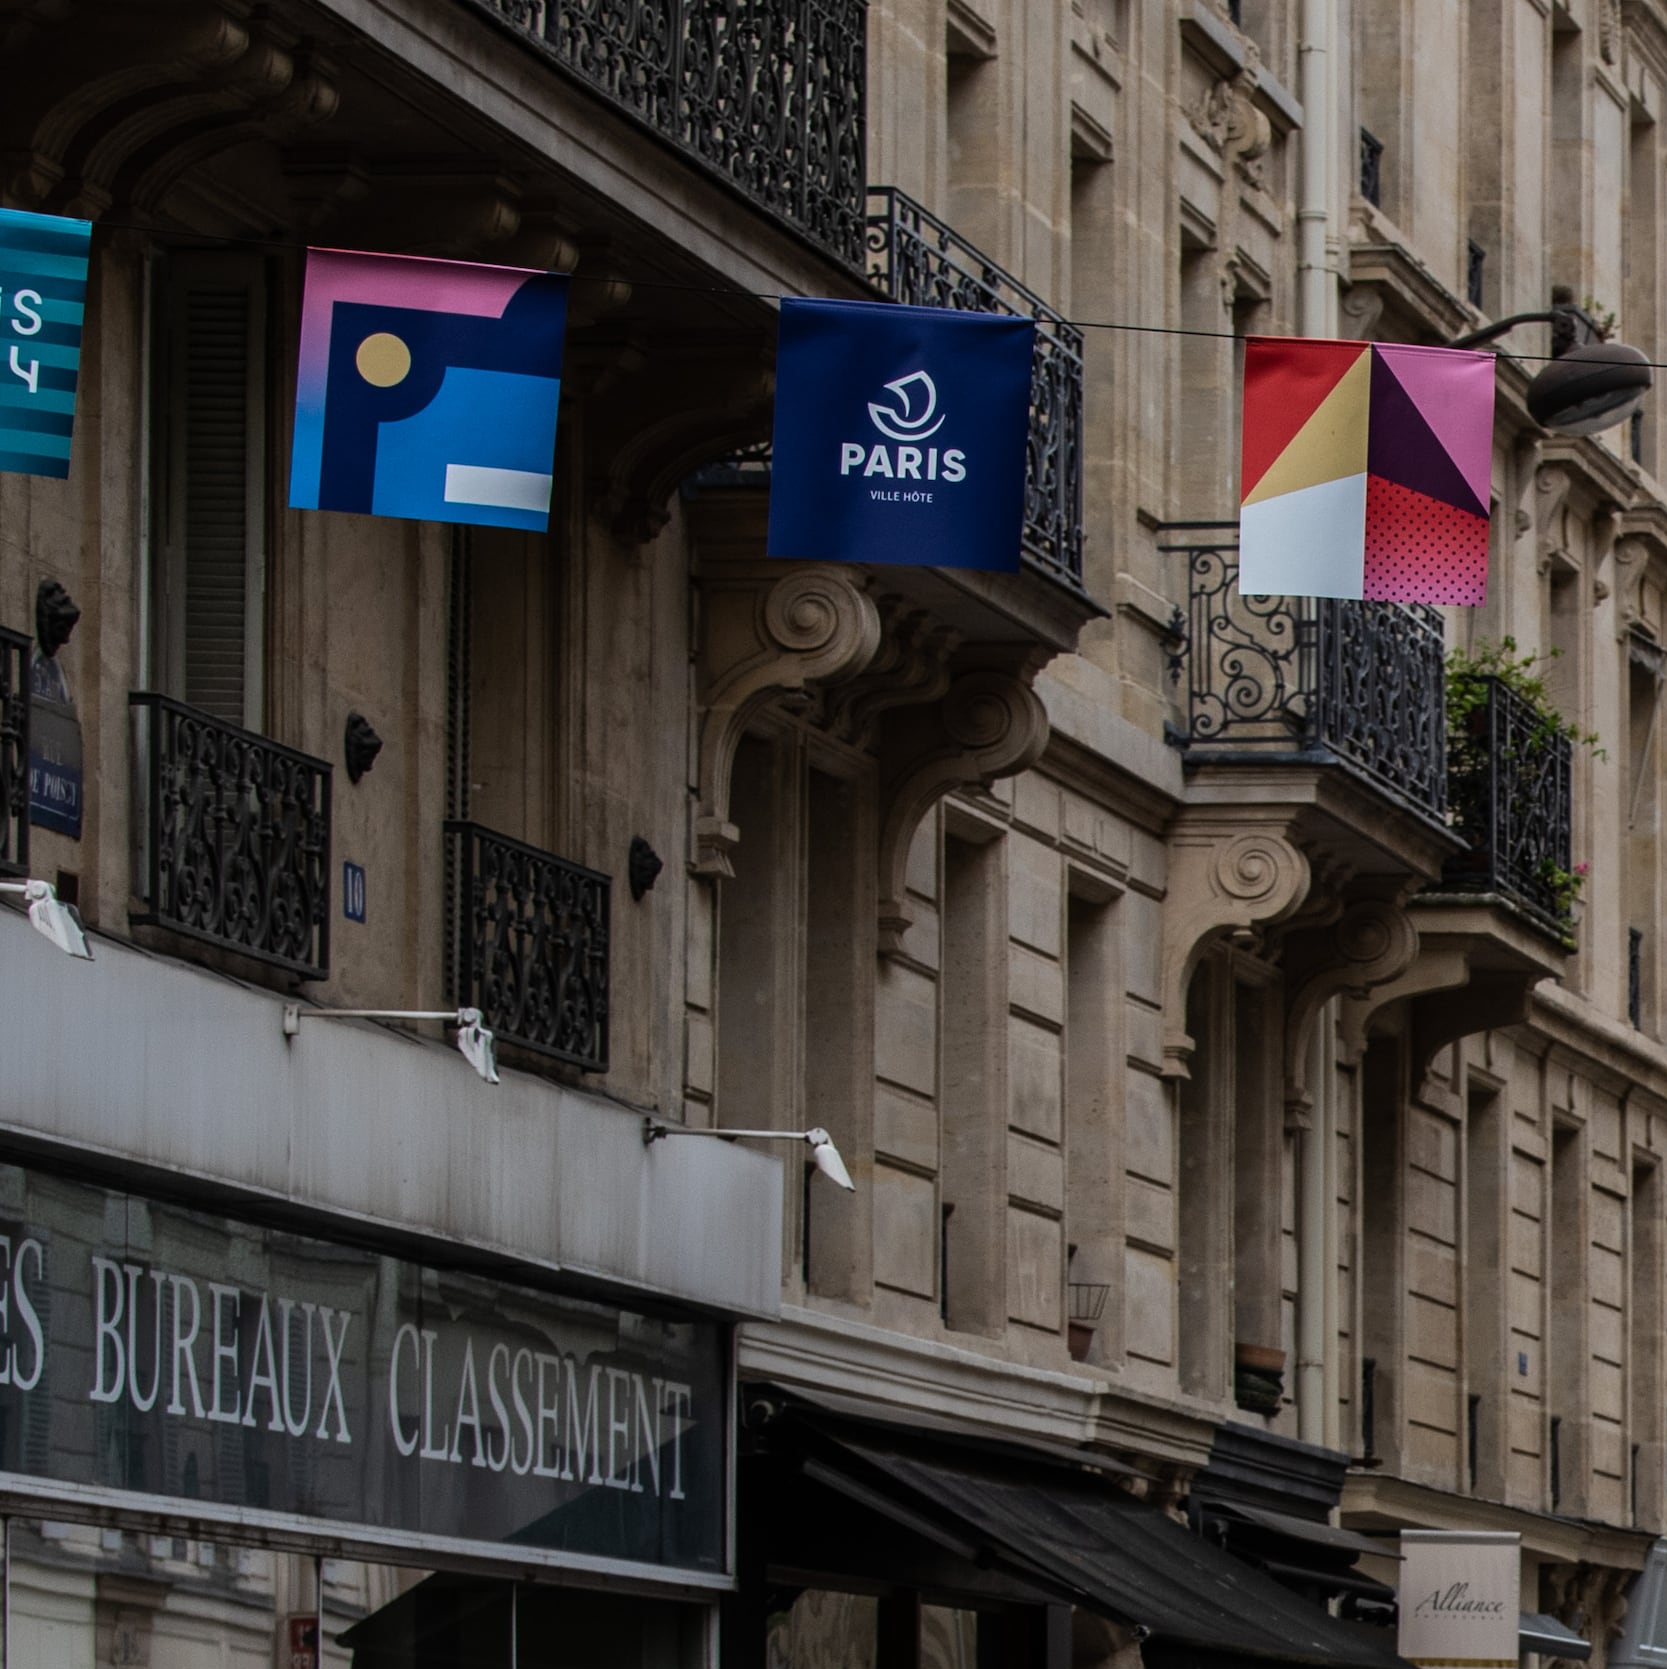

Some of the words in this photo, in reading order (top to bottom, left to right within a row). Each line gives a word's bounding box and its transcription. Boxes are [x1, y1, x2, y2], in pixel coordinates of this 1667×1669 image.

[0, 287, 43, 336] S
[840, 442, 967, 483] PARIS
[870, 490, 900, 502] VILLE
[903, 491, 934, 504] HÔTE
[347, 867, 364, 917] 10
[90, 1255, 352, 1444] BUREAUX
[388, 1322, 693, 1500] CLASSEMENT
[1415, 1582, 1505, 1613] Alliance
